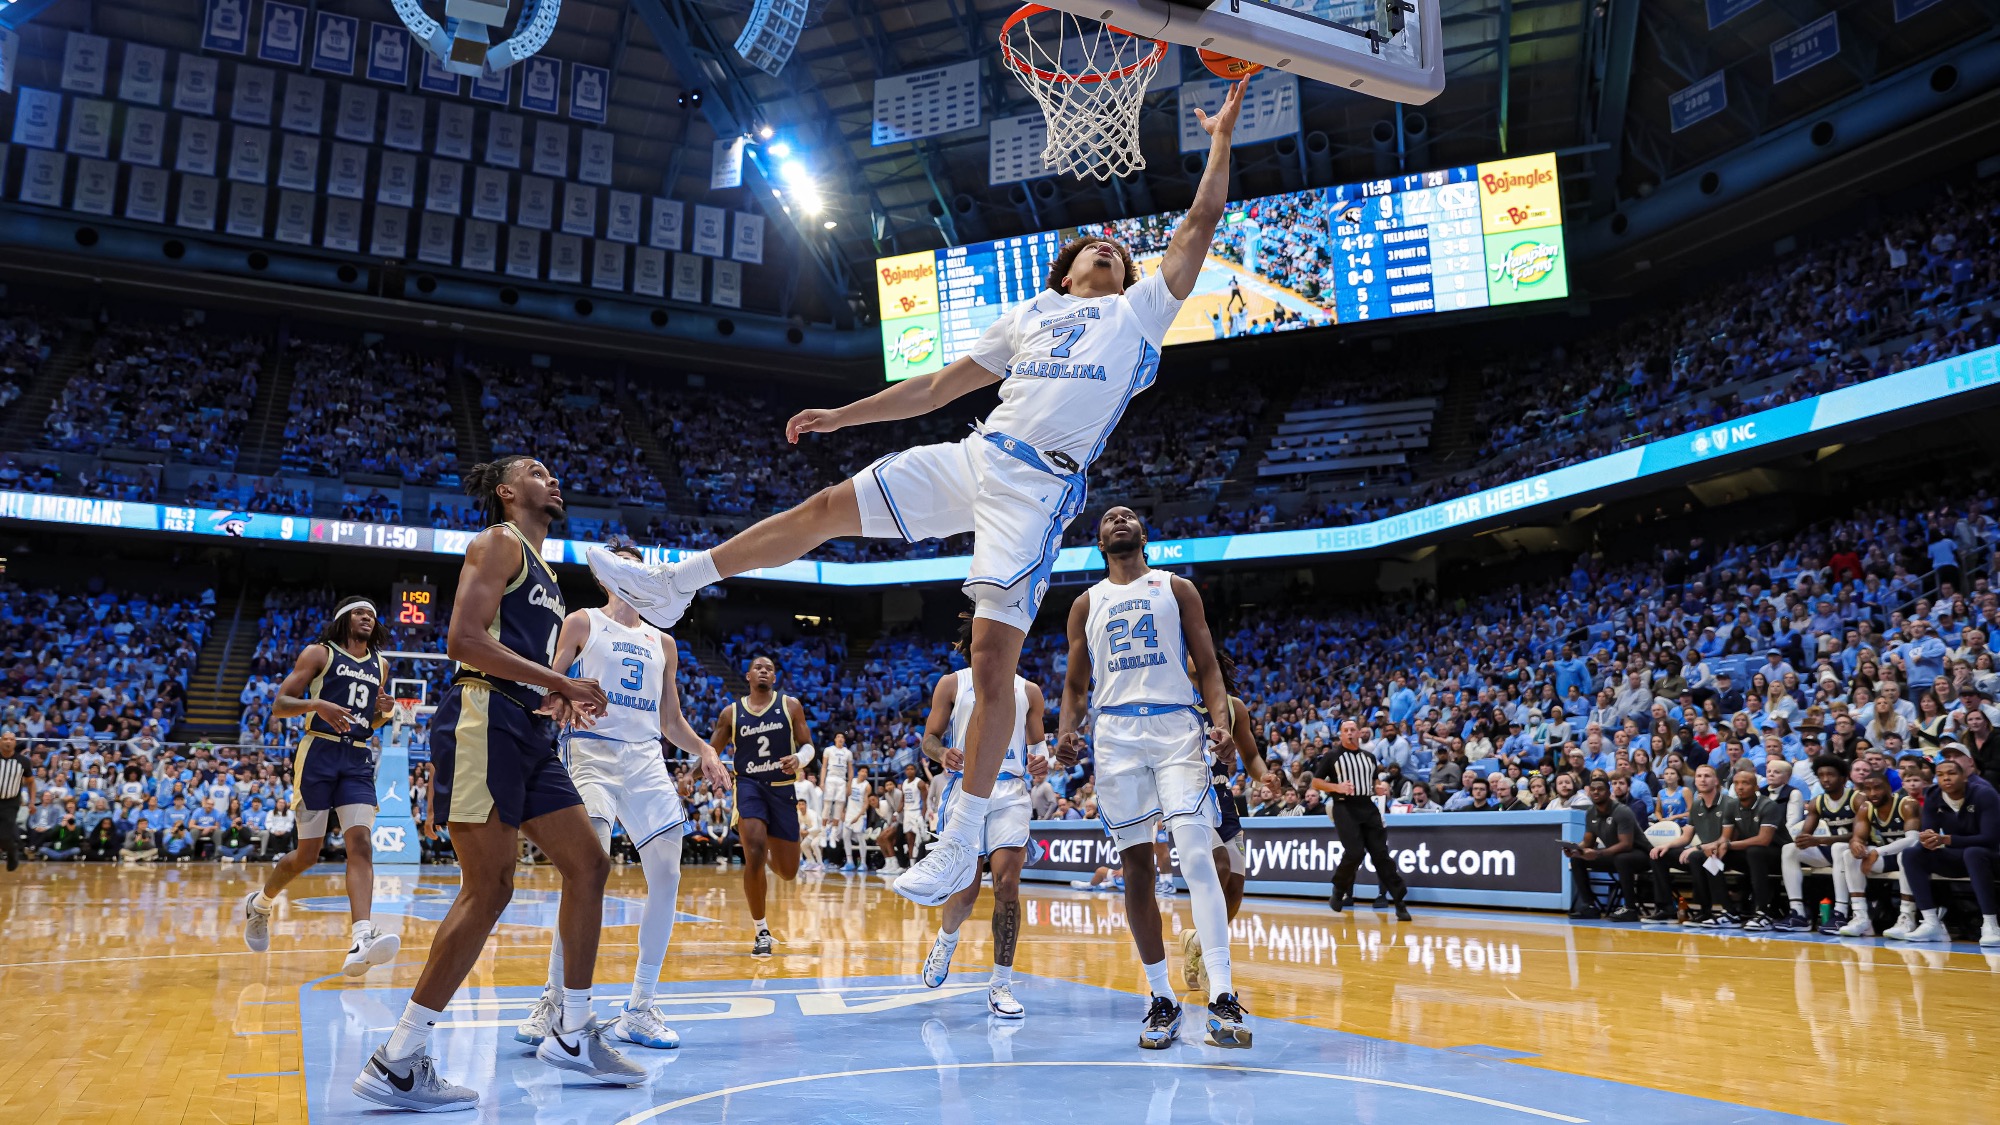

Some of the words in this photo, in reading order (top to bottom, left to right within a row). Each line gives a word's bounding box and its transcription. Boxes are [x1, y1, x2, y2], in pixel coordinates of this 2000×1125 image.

[1791, 37, 1819, 59] 2011
[1362, 179, 1392, 197] 11:50
[1428, 172, 1444, 186] 26
[1482, 168, 1554, 200] Bojangles
[1380, 195, 1393, 219] 9
[1408, 190, 1431, 215] 22
[1354, 224, 1360, 234] 2
[1392, 218, 1398, 229] 3
[1341, 234, 1374, 253] 4-12
[1384, 232, 1403, 244] FIELD
[1404, 229, 1428, 242] GOALS
[1030, 244, 1038, 256] 0
[1394, 248, 1418, 260] POINT
[1347, 253, 1372, 269] 1-4
[1490, 243, 1559, 282] Hampton
[881, 263, 934, 287] Bojangles
[1347, 271, 1374, 286] 0-0
[1386, 267, 1403, 280] FREE
[1403, 264, 1432, 278] THROWS
[1512, 259, 1554, 290] Farms
[1357, 288, 1368, 302] 5
[1391, 282, 1430, 297] REBOUNDS
[1358, 304, 1370, 320] 2
[1390, 298, 1434, 315] TURNOVERS
[1050, 323, 1086, 358] 7
[1016, 361, 1106, 382] CAROLINA
[1946, 353, 2000, 389] HE
[1731, 422, 1757, 444] NC
[32, 496, 123, 526] AMERICANS
[164, 507, 186, 520] TOL:
[188, 508, 196, 521] 3
[164, 520, 185, 532] FLS:
[186, 521, 194, 532] 2
[279, 517, 294, 540] 9
[1315, 526, 1372, 550] HERE
[1377, 516, 1410, 542] FOR
[1411, 507, 1444, 534] THE
[1444, 498, 1482, 524] TAR
[330, 522, 354, 543] 1ST
[364, 524, 418, 549] 11:50
[444, 532, 466, 552] 22
[1164, 546, 1183, 559] NC
[402, 591, 430, 604] 11:50
[400, 602, 425, 624] 26
[1108, 598, 1152, 618] NORTH
[1106, 614, 1158, 655] 24
[612, 642, 652, 660] NORTH
[1108, 652, 1168, 672] CAROLINA
[336, 664, 380, 686] Charleston
[620, 657, 644, 691] 3
[347, 681, 370, 709] 13
[602, 690, 657, 712] AROLINA
[740, 721, 784, 737] Charleston
[757, 736, 771, 758] 2
